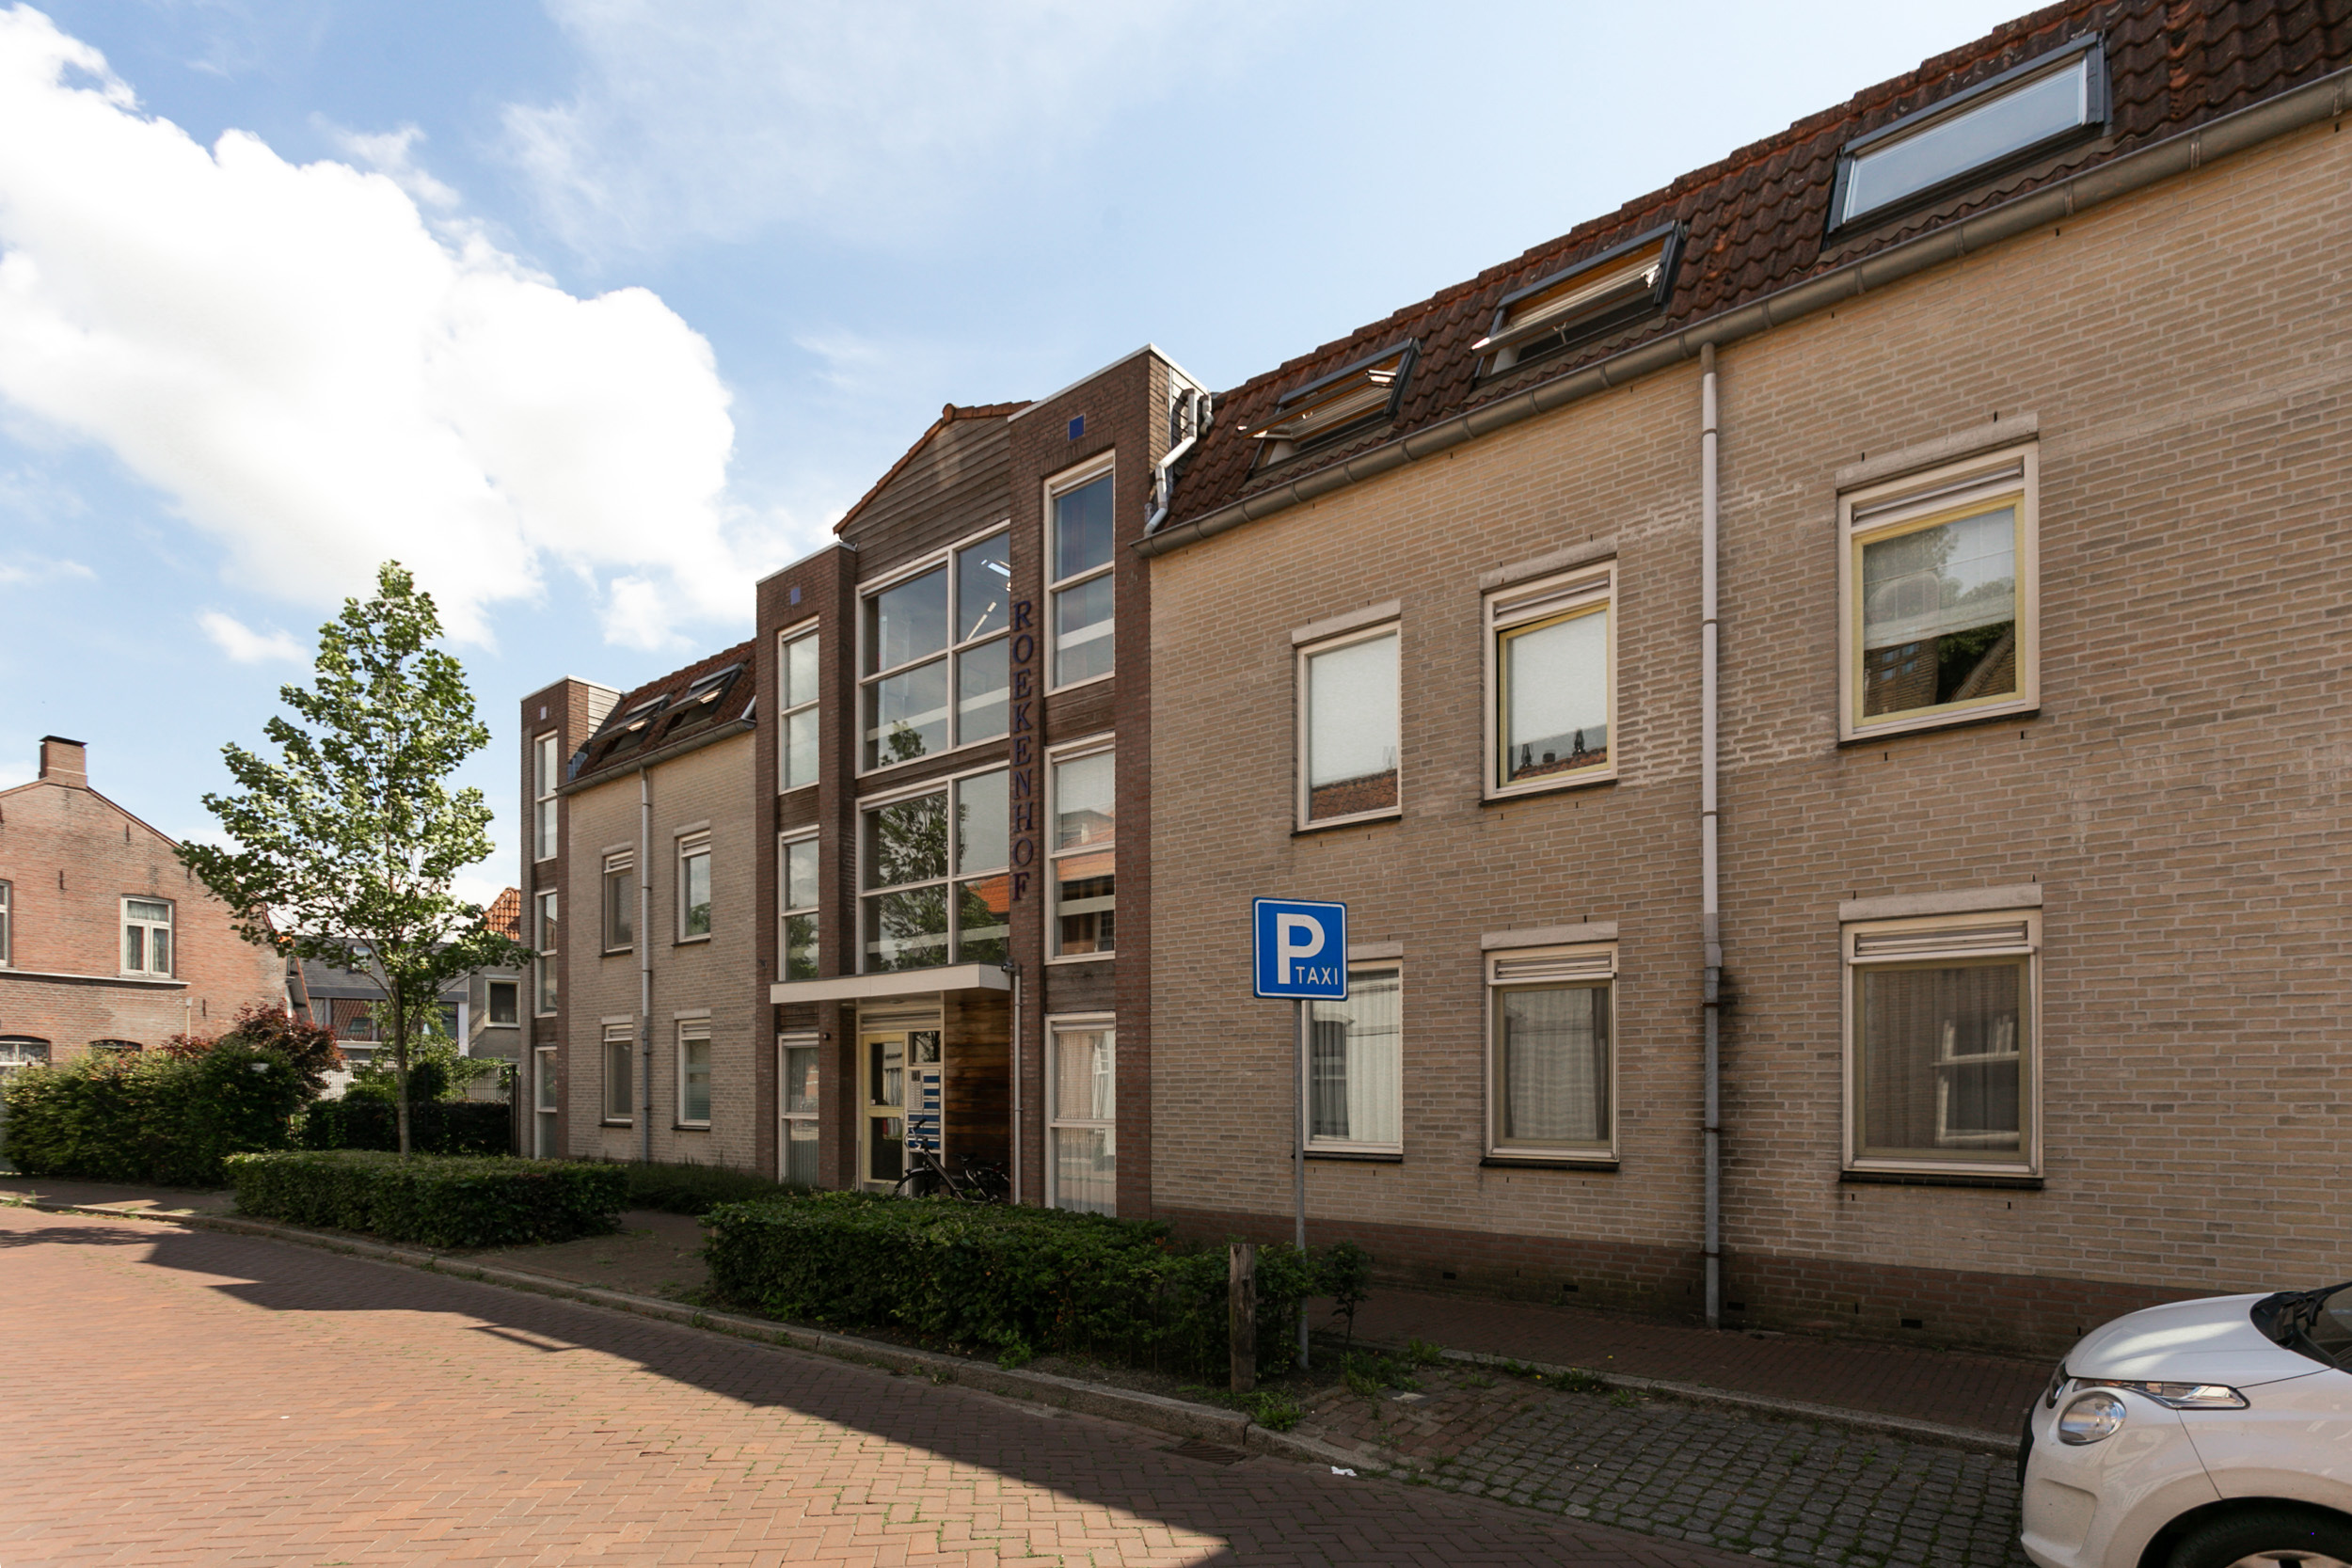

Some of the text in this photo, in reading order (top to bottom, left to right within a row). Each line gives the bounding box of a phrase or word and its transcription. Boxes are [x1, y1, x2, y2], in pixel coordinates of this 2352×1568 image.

[1012, 600, 1034, 901] ROEKENHOF
[1277, 912, 1325, 984] P
[1295, 966, 1338, 985] TAXI
